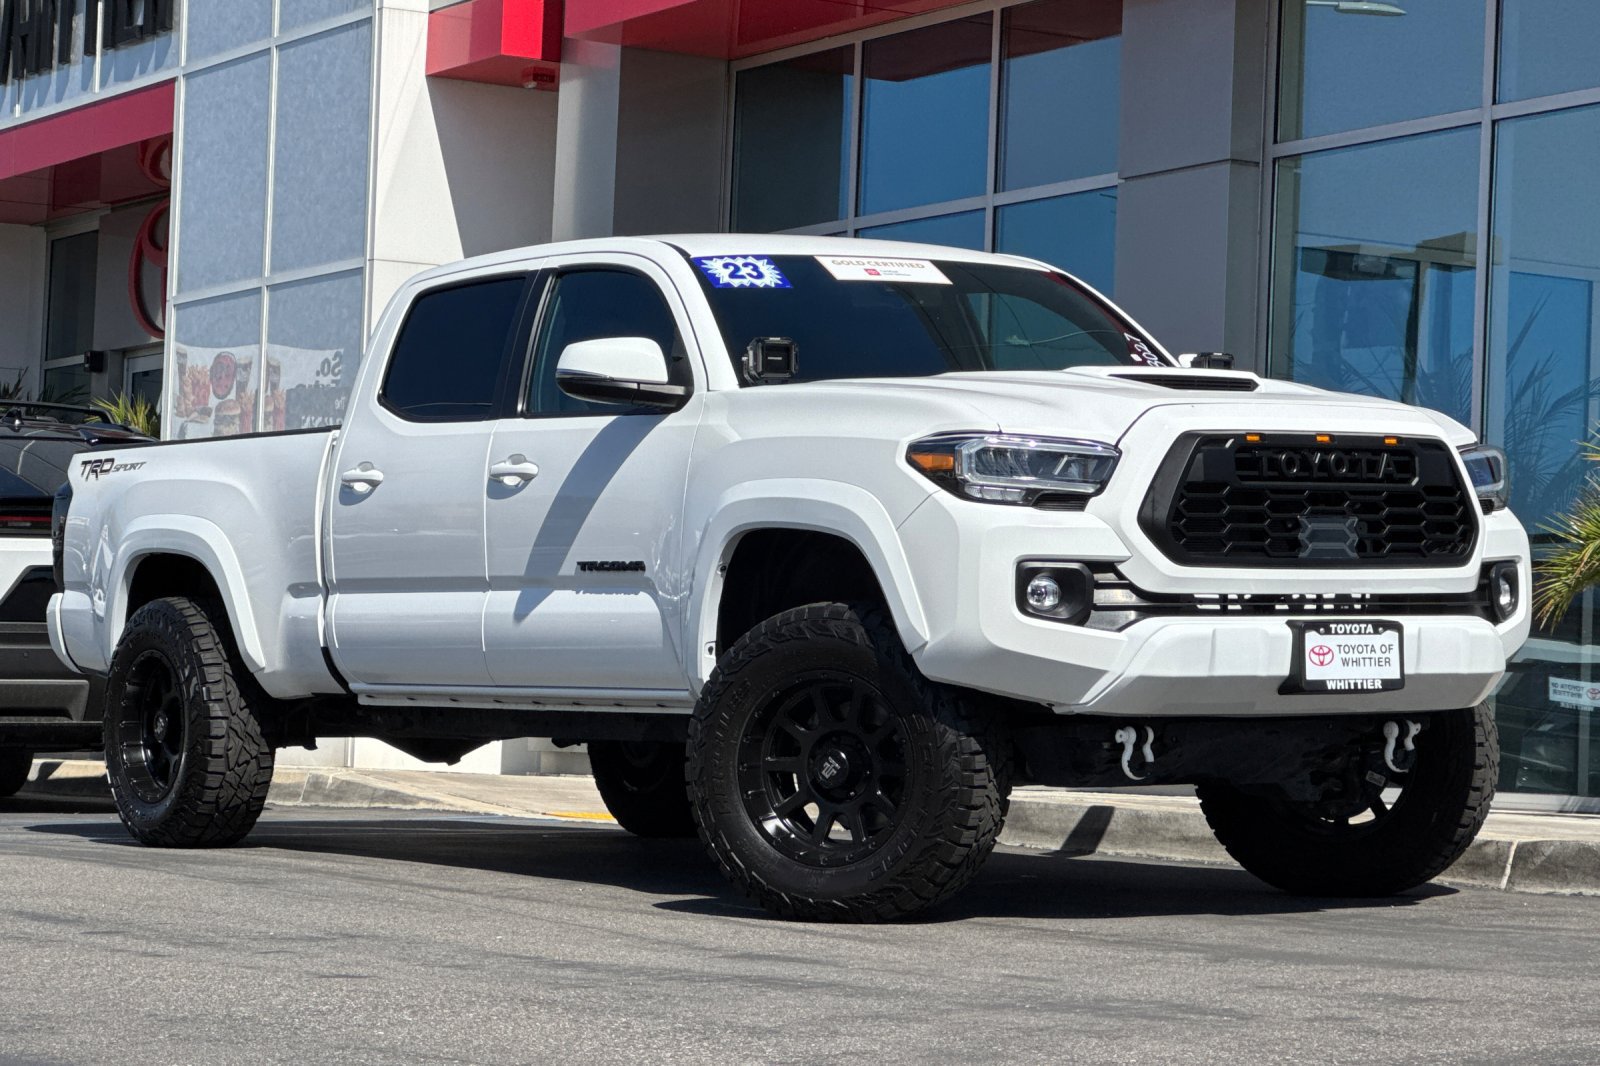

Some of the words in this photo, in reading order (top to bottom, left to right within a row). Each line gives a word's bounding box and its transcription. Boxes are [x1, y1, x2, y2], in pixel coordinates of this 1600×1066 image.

[867, 261, 925, 269] CERTIFIED
[722, 262, 765, 280] 23
[81, 457, 115, 481] TRD
[112, 461, 147, 473] SPORT
[1252, 449, 1398, 480] TOYOTA
[576, 560, 646, 572] TACOMA
[1329, 623, 1374, 634] TOYOTA
[1336, 644, 1377, 655] TOYOTA
[1380, 644, 1394, 654] OF
[1341, 656, 1391, 667] WHITTIER
[1326, 679, 1382, 690] WHITTIER
